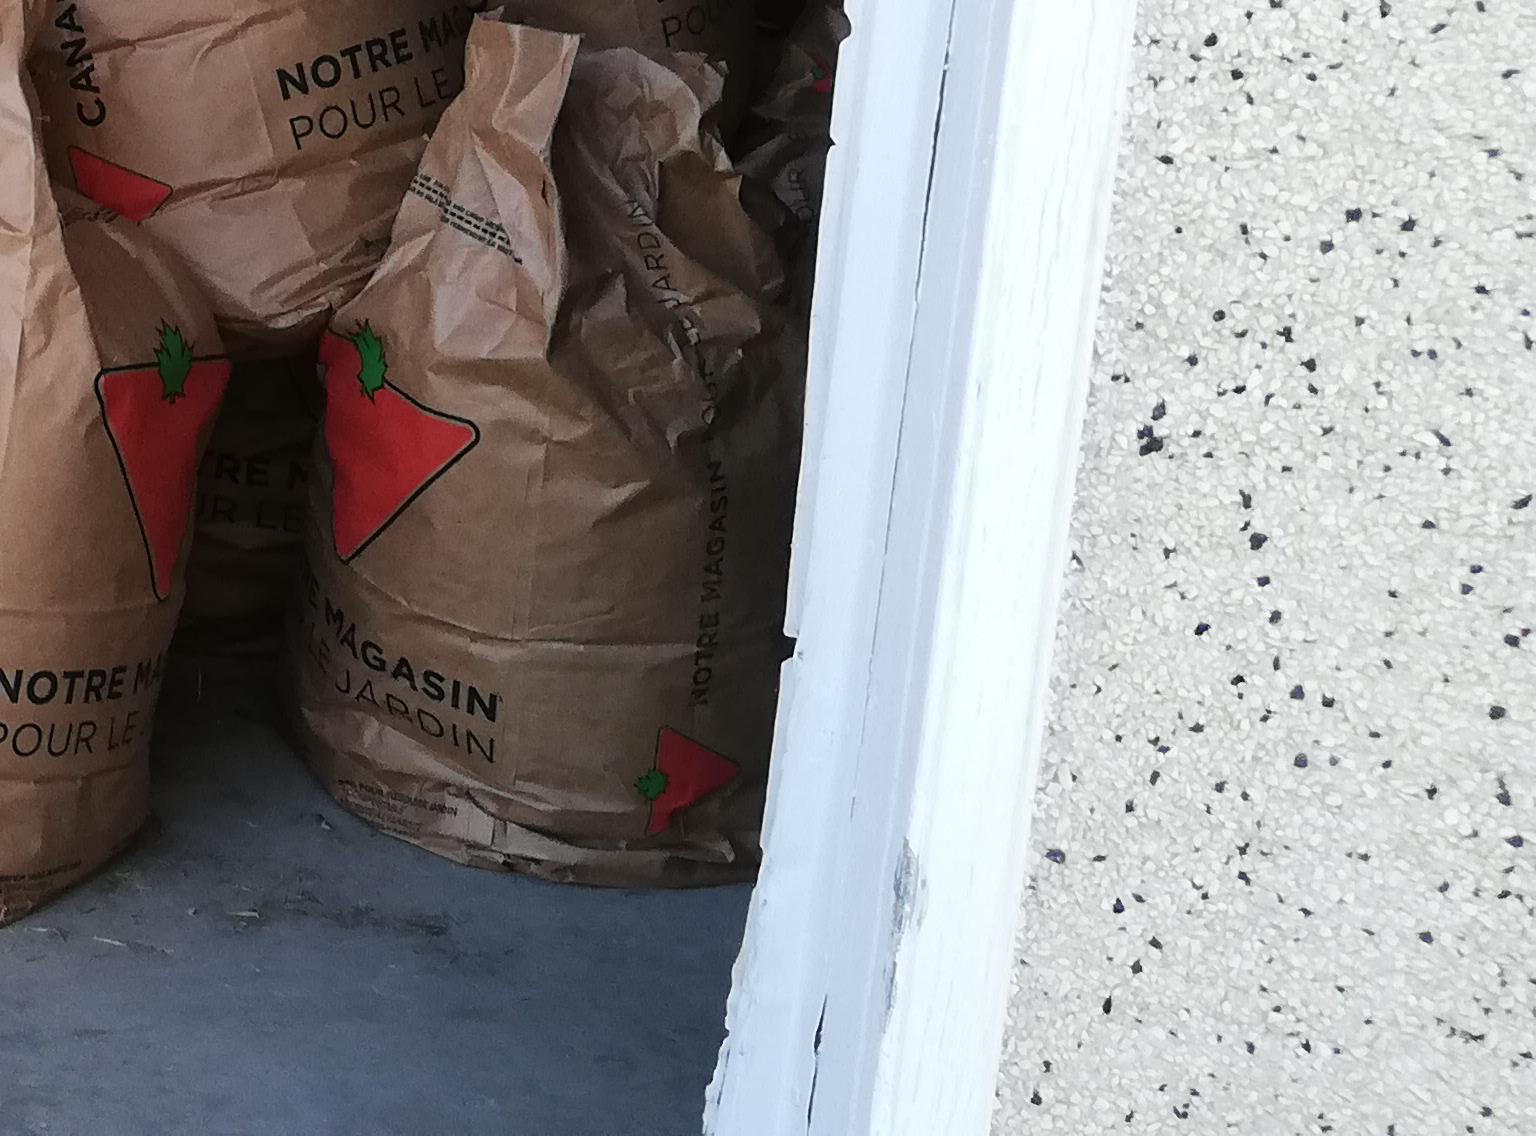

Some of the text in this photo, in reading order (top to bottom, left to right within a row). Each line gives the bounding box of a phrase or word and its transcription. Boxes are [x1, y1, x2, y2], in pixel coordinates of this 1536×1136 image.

[276, 28, 413, 101] NOTRE
[289, 67, 454, 150] POUR LE
[325, 597, 498, 723] MAGASIN
[335, 669, 494, 764] JARDIN
